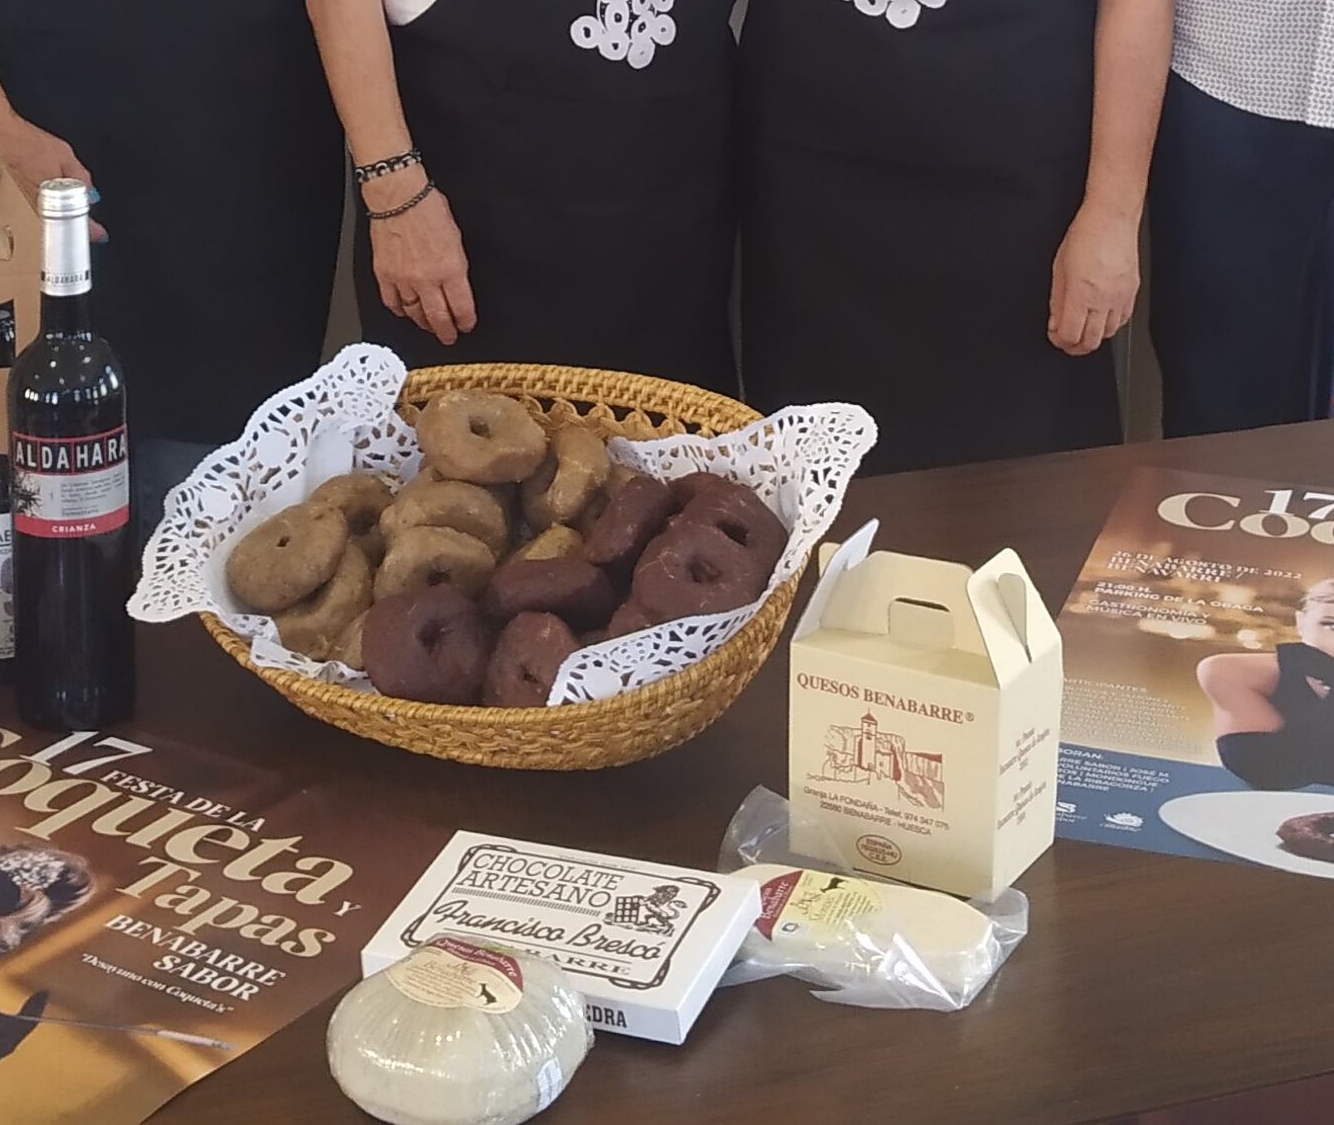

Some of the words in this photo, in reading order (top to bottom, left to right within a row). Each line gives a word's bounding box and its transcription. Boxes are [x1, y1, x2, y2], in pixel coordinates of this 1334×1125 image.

[15, 433, 127, 469] ALDAHARA
[51, 523, 97, 533] CRIANZA
[1164, 556, 1233, 571] AGOSTO
[1235, 565, 1260, 574] DE
[1262, 569, 1303, 580] 2022
[1094, 586, 1160, 601] PARKING
[1163, 594, 1185, 604] DE
[1186, 597, 1207, 606] LA
[1209, 600, 1265, 613] OBAGA
[1146, 612, 1168, 621] EN
[1169, 613, 1208, 625] VIVO
[796, 672, 860, 700] QUESOS
[862, 687, 965, 725] BENABARRE
[19, 730, 153, 775] 17
[100, 769, 185, 805] FESTA
[184, 797, 231, 818] DE
[225, 811, 266, 832] LA
[803, 786, 828, 800] Granja
[828, 790, 839, 801] LA
[904, 811, 919, 823] 974
[842, 806, 892, 826] BENABARRE
[897, 821, 932, 836] HUESCA
[456, 870, 612, 908] ARTESANO
[472, 852, 625, 891] CHOCOLATE
[116, 855, 336, 959] Tapas
[334, 900, 362, 918] Y
[433, 900, 564, 942] Francisco
[565, 923, 666, 960] Brescó
[104, 913, 287, 987] BENABARRE
[152, 954, 267, 1002] SABOR
